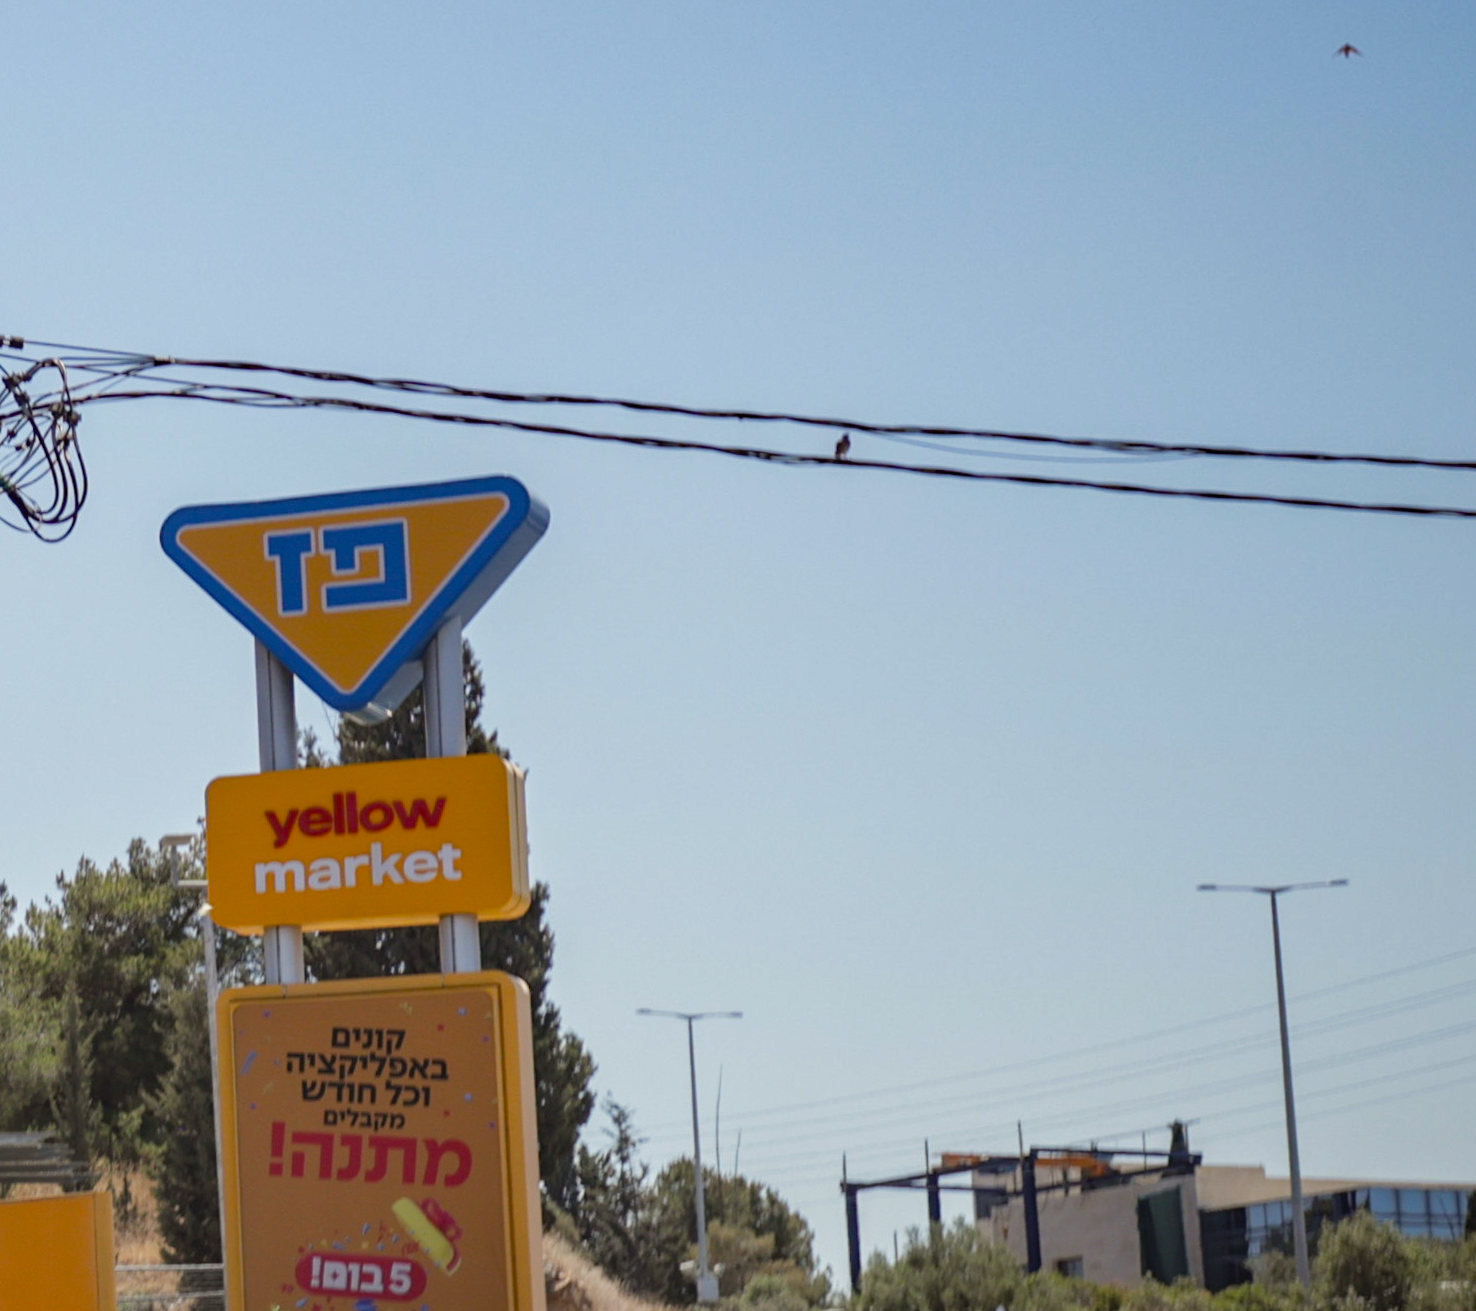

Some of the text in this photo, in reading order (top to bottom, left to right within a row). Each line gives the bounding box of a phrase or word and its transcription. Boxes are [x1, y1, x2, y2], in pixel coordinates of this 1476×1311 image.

[263, 518, 411, 616] פז
[264, 792, 447, 848] yellow
[254, 842, 462, 894] market
[331, 1026, 407, 1053] קונים
[286, 1049, 449, 1081] באפליקציה
[301, 1079, 431, 1107] וכל חודש
[323, 1108, 406, 1130] מקבלים
[269, 1121, 473, 1187] מתנה!
[311, 1256, 412, 1294] 5 בום!
